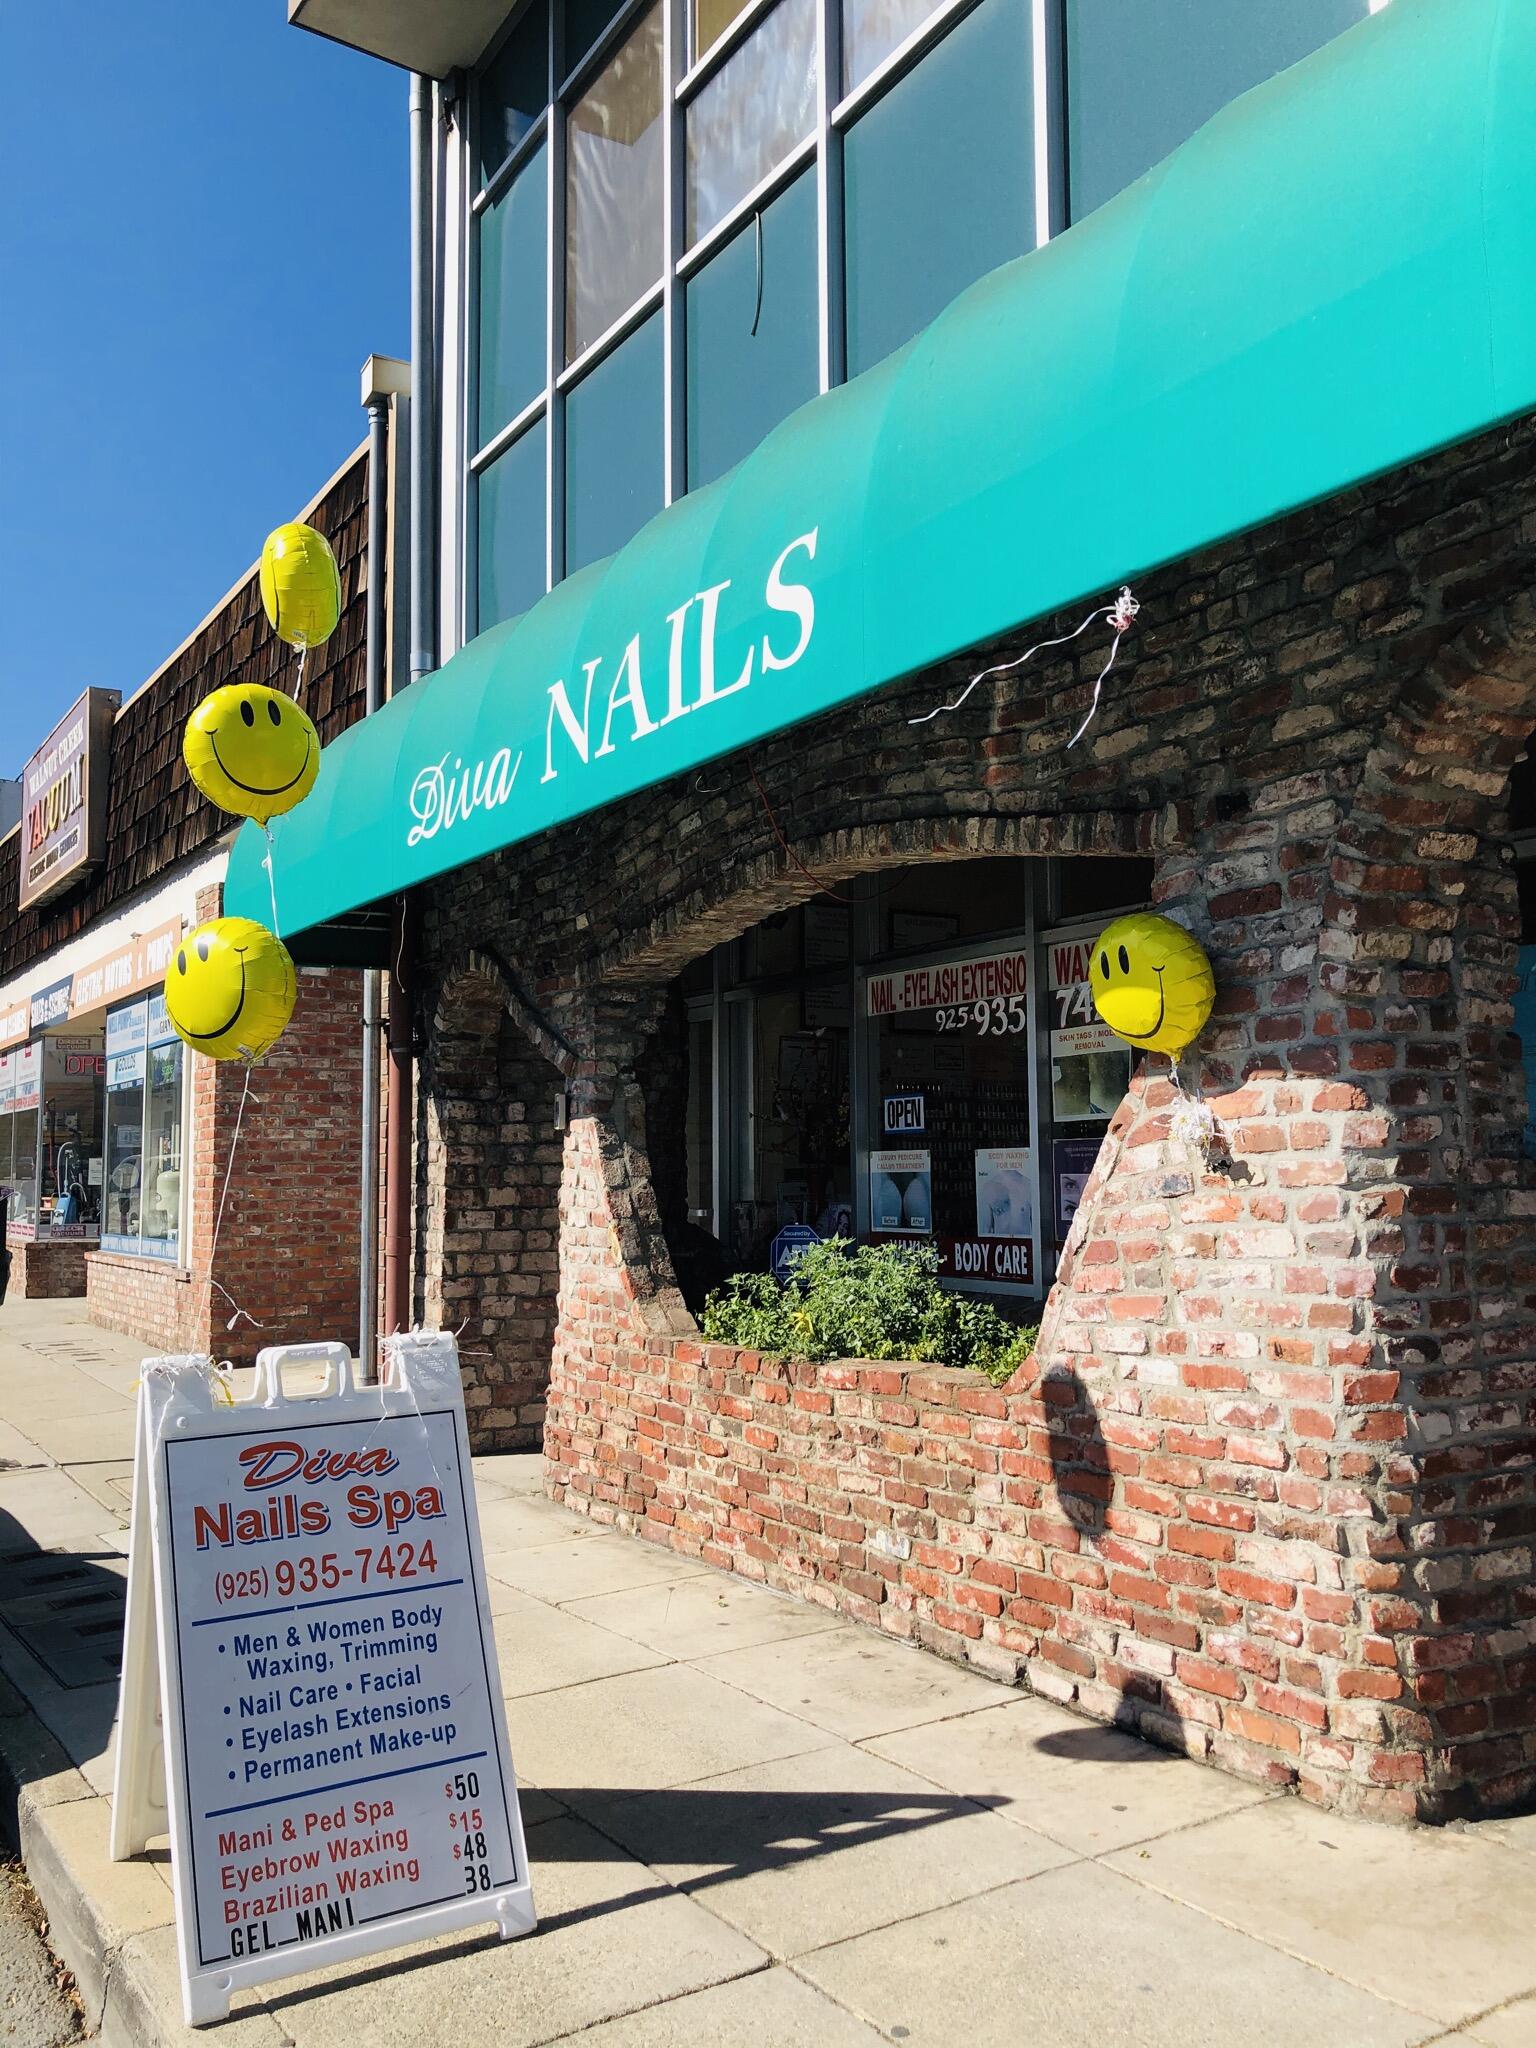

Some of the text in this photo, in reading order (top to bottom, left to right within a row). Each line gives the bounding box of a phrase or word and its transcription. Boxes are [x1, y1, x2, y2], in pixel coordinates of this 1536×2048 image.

[407, 526, 819, 847] Diva NAILS
[58, 717, 84, 764] CREEK
[27, 752, 84, 854] VACUUM
[871, 978, 897, 1014] NAIL
[904, 967, 959, 1008] EYELASH
[962, 954, 1027, 1001] EXTENSIO
[1059, 1033, 1075, 1042] SKIN
[1076, 1031, 1092, 1040] TAGS
[1074, 1040, 1106, 1051] REMOVAL
[888, 1100, 922, 1129] OPEN
[896, 1162, 925, 1170] TREATMENT
[898, 1152, 923, 1161] PEDICURE
[1010, 1161, 1023, 1169] MEN
[804, 1230, 811, 1238] by
[954, 1242, 990, 1272] BODY
[994, 1244, 1028, 1275] CARE
[239, 1440, 399, 1491] Diva
[193, 1484, 447, 1551] Nails Spa
[215, 1539, 438, 1605] (925) 935-7424
[233, 1604, 443, 1657] Men & Women Body
[247, 1632, 438, 1680] Waxing, Trimming
[239, 1664, 422, 1719] Nail Care Facial
[241, 1693, 451, 1753] Eyelash Extensions
[244, 1722, 457, 1783] Permanent Make-up
[218, 1771, 479, 1857] Mani & Ped Spa $50
[221, 1808, 483, 1893] Eyebrow Waxing $15
[224, 1832, 487, 1924] Brazilian Waxing $48
[230, 1863, 491, 1958] GEL MANI 38
